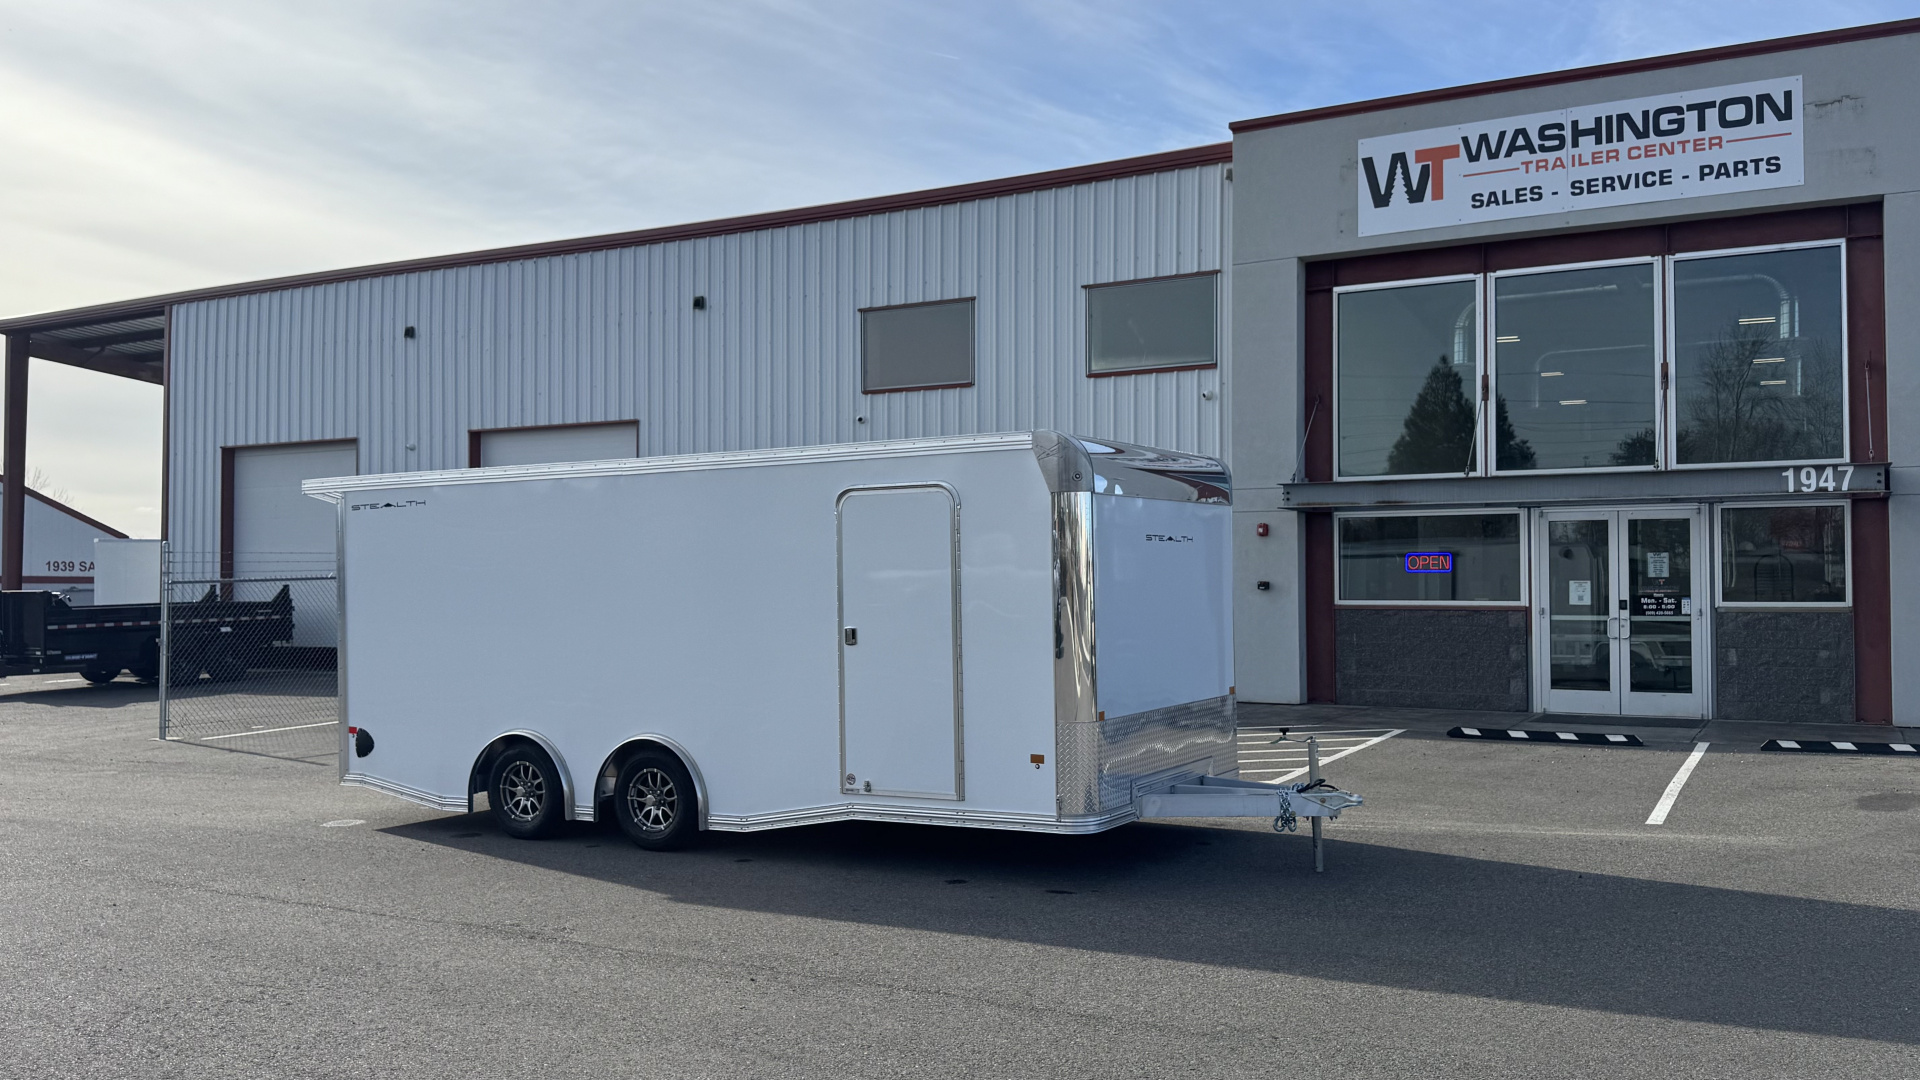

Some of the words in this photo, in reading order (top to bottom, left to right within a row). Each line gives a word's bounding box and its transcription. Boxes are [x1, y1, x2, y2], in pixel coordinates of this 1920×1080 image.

[1461, 90, 1793, 163] WASHINGTON
[1521, 148, 1619, 174] TRAILER
[1627, 136, 1723, 161] CENTER
[1361, 144, 1461, 209] WT
[1471, 185, 1543, 209] SALES
[1570, 168, 1673, 197] SERVICE
[1699, 156, 1782, 182] PARTS
[1782, 465, 1855, 493] 1947
[351, 500, 427, 511] STEALTH
[1145, 534, 1194, 543] STEALTH
[45, 560, 75, 572] 1939
[1408, 555, 1450, 570] OPEN
